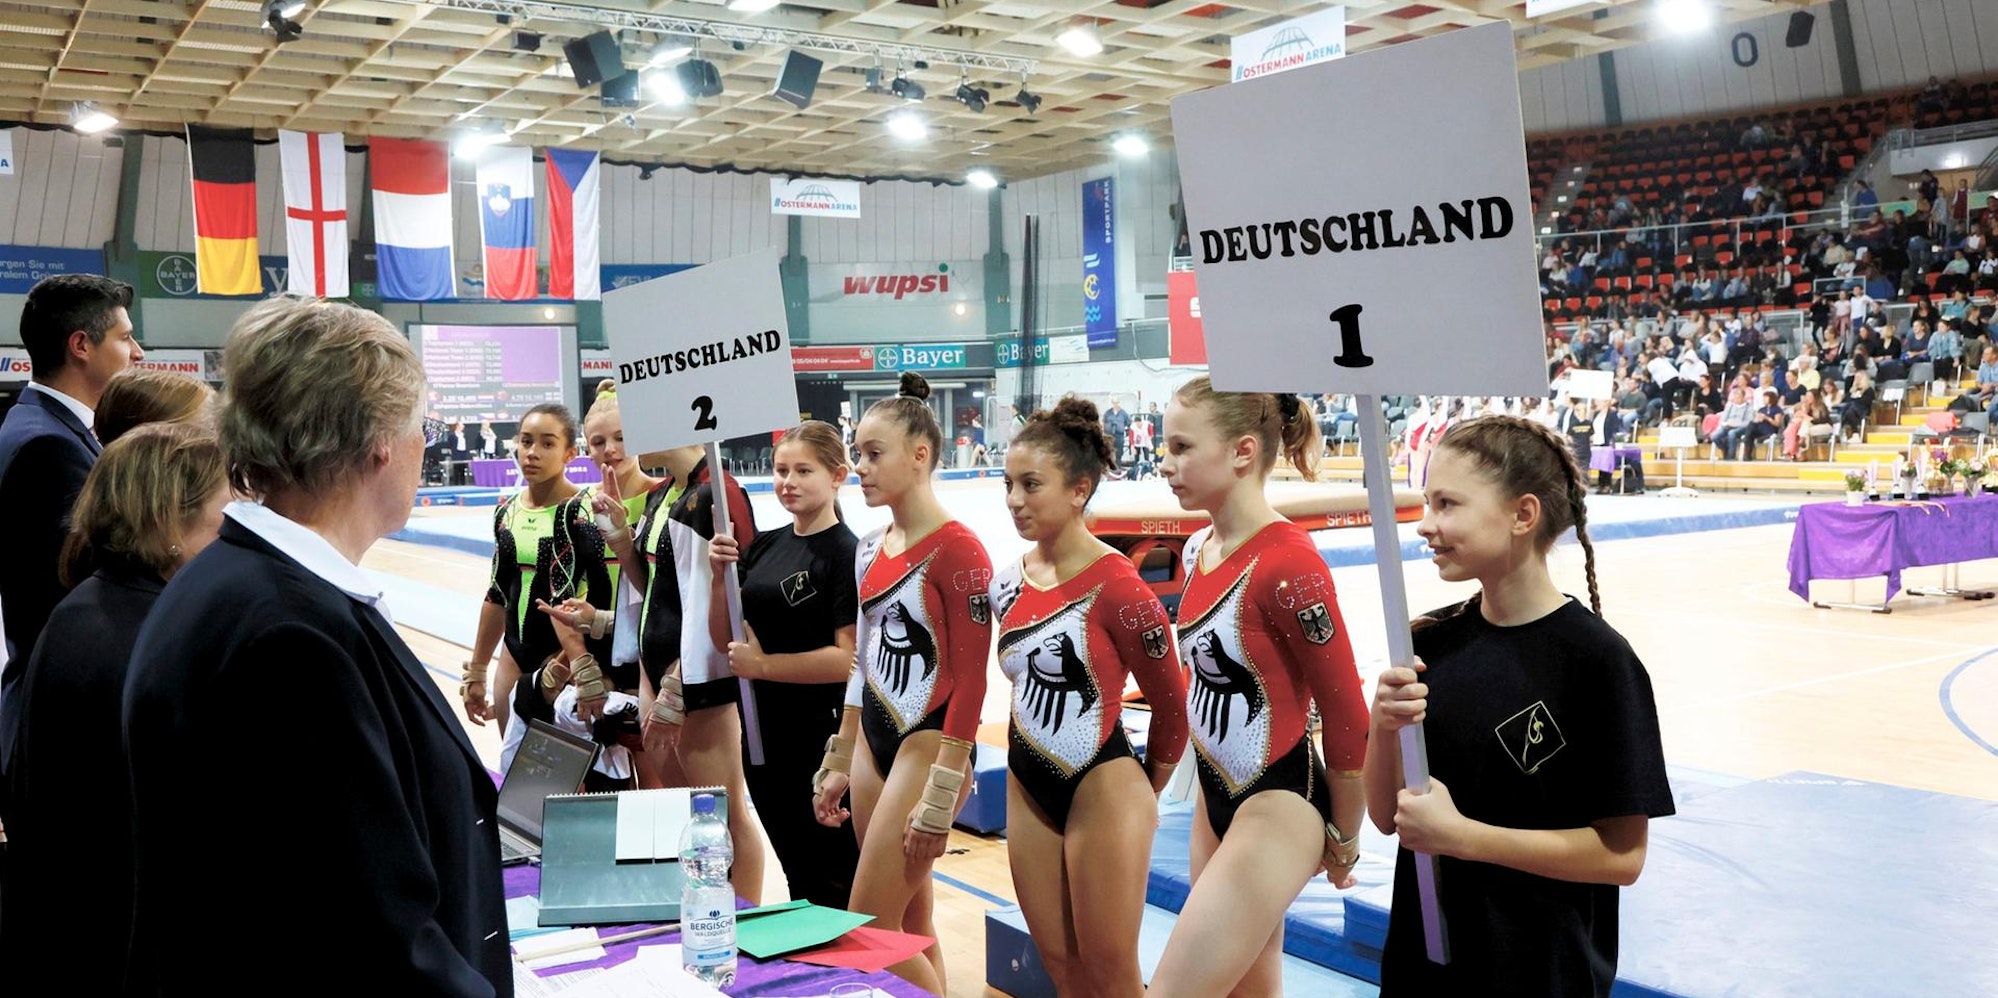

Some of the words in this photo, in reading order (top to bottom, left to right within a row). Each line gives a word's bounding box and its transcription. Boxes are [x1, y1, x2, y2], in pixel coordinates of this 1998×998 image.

[1200, 196, 1514, 264] DEUTSCHLAND
[160, 271, 195, 279] BAYER
[844, 263, 949, 300] wupsi
[1329, 304, 1374, 368] 1
[619, 330, 781, 384] DEUTSCHLAND
[902, 347, 963, 368] Bayer
[691, 395, 717, 431] 2
[1141, 520, 1180, 534] SPIETH
[1326, 511, 1372, 527] SPIETH
[1275, 572, 1329, 610] GER
[1119, 599, 1166, 630] GER
[690, 917, 733, 931] BERGISCHE
